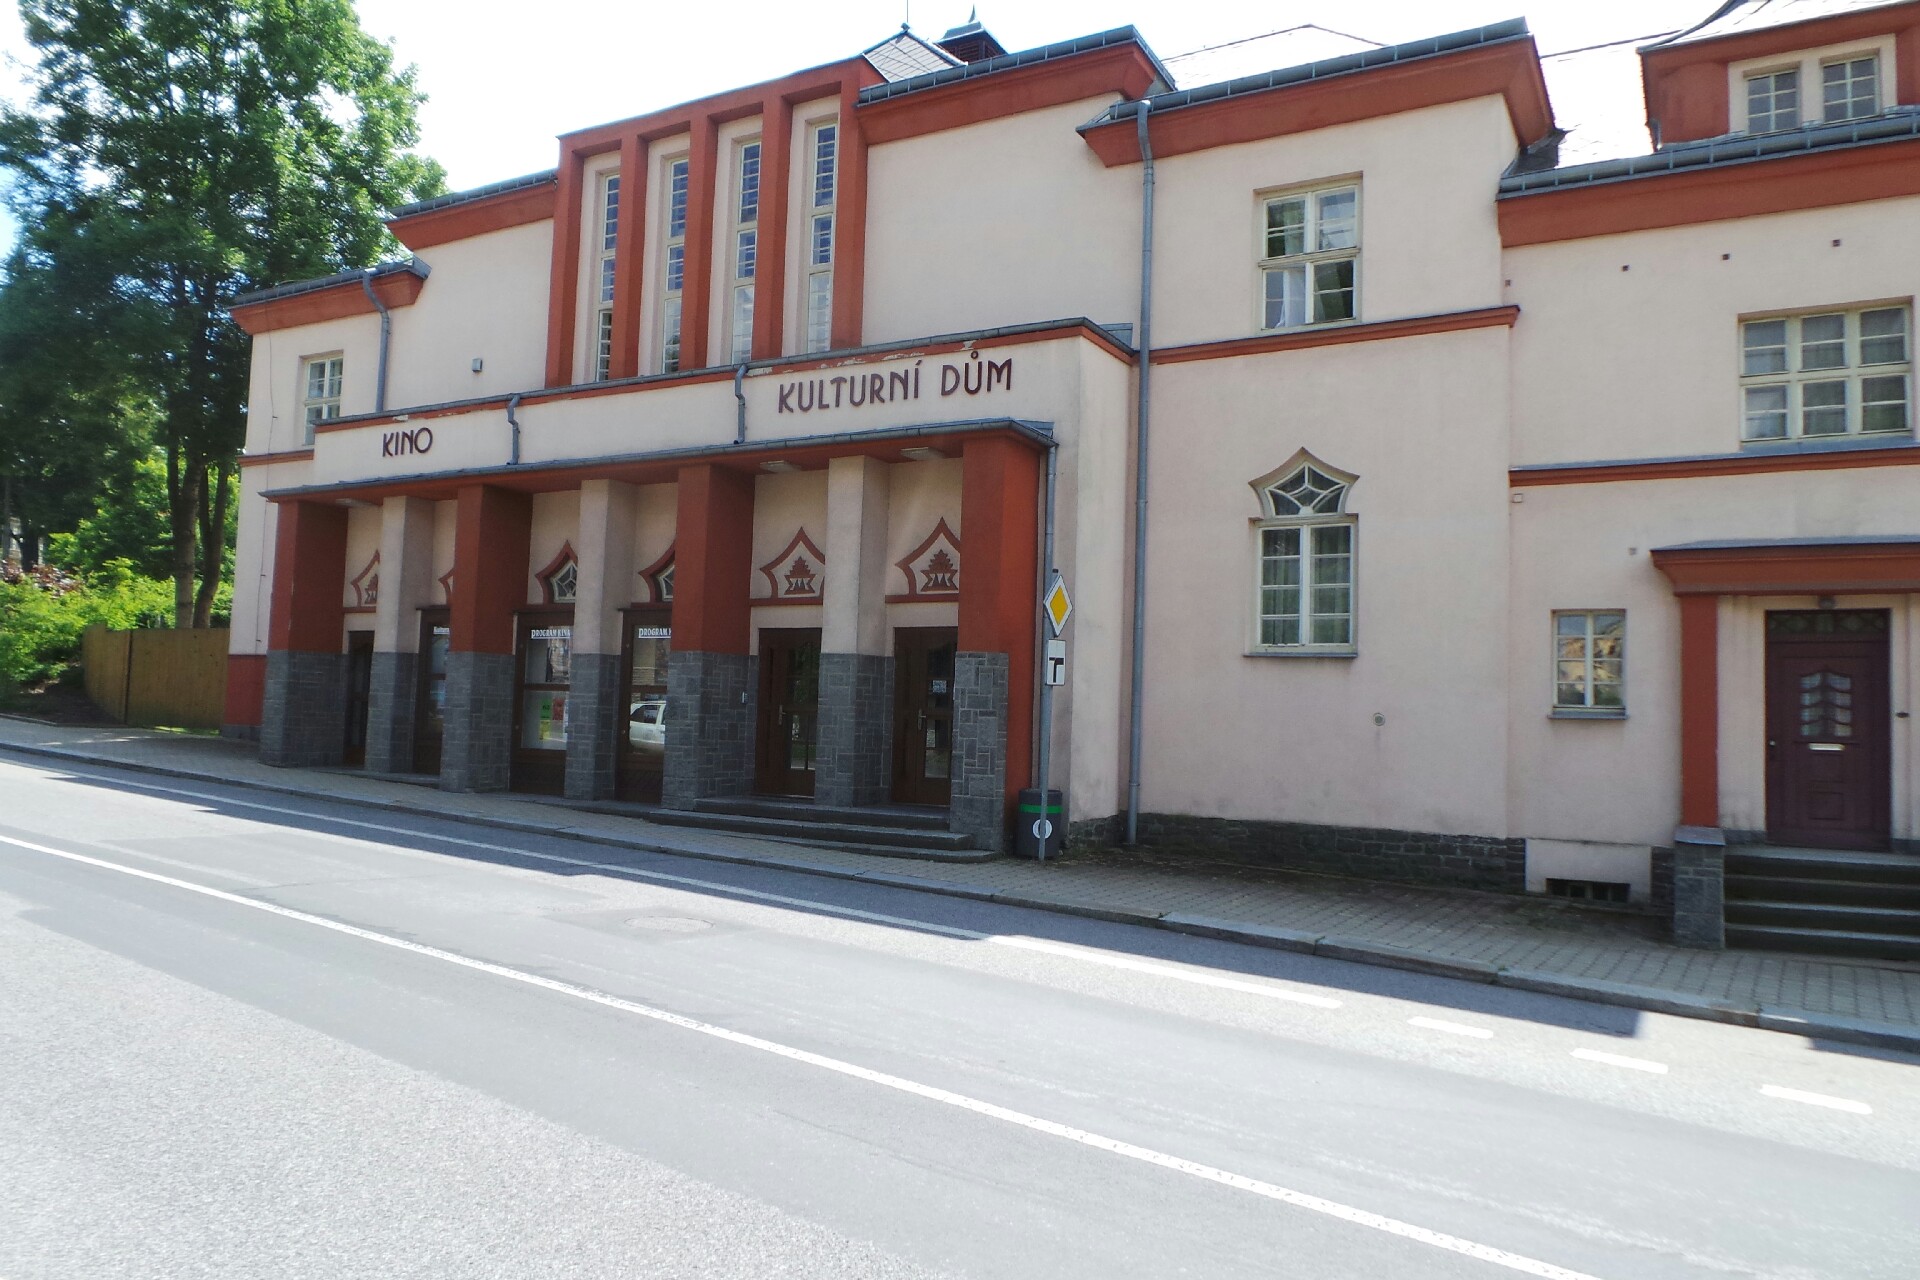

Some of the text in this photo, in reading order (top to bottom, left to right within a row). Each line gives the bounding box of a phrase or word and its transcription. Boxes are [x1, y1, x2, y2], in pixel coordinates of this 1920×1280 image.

[778, 351, 1012, 413] KULTURNÍ DŮM
[382, 427, 433, 457] KINO
[531, 629, 557, 639] PROGRAM
[638, 628, 668, 638] PROGRAM
